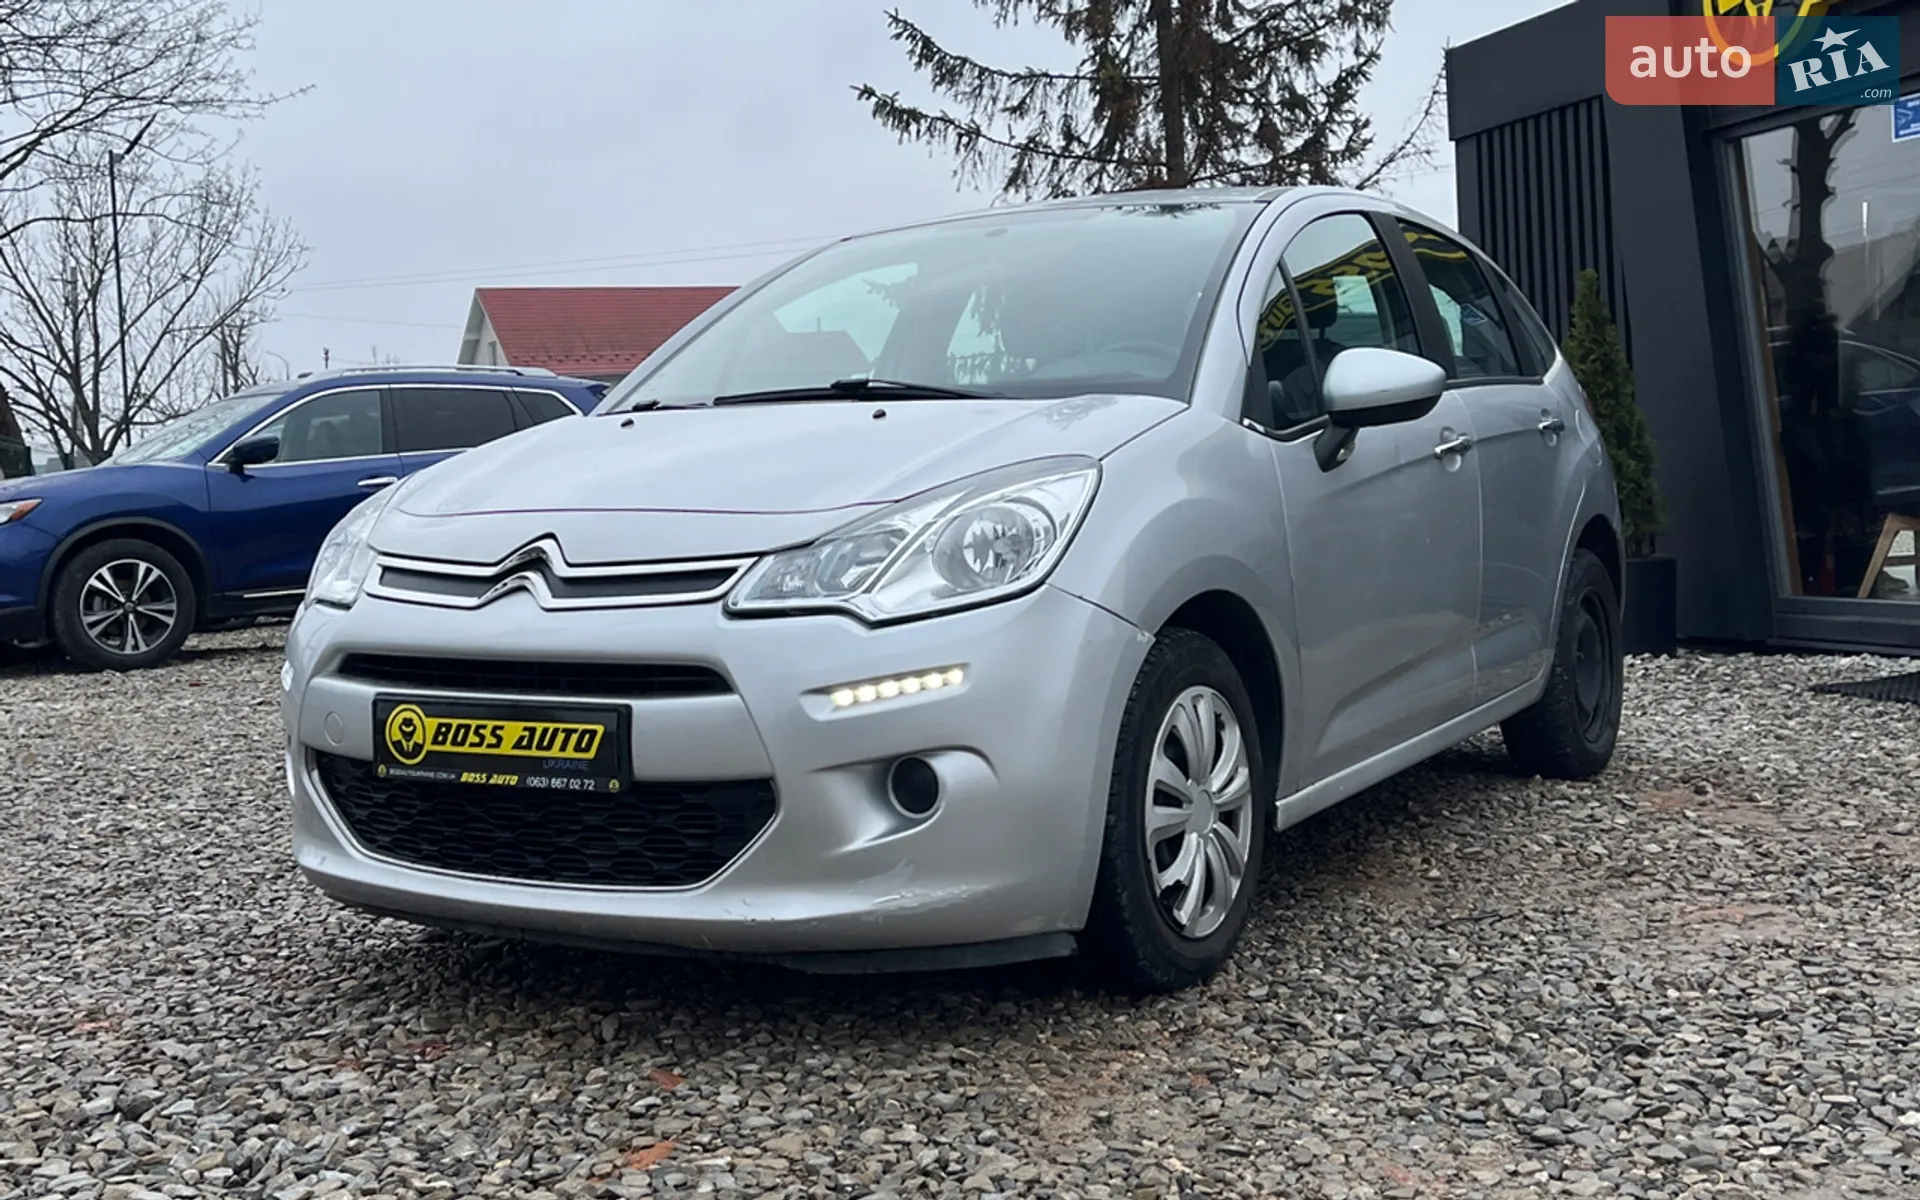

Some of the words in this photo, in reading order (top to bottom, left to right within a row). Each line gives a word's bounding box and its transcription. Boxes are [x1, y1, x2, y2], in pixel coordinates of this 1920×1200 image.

[430, 722, 504, 748] BOSS
[511, 726, 599, 753] AUTO
[543, 758, 589, 771] UKRAINE
[460, 772, 488, 783] BOSS
[487, 774, 519, 786] AUTO
[526, 776, 549, 788] (063)
[569, 778, 581, 790] 02
[583, 779, 595, 790] 72
